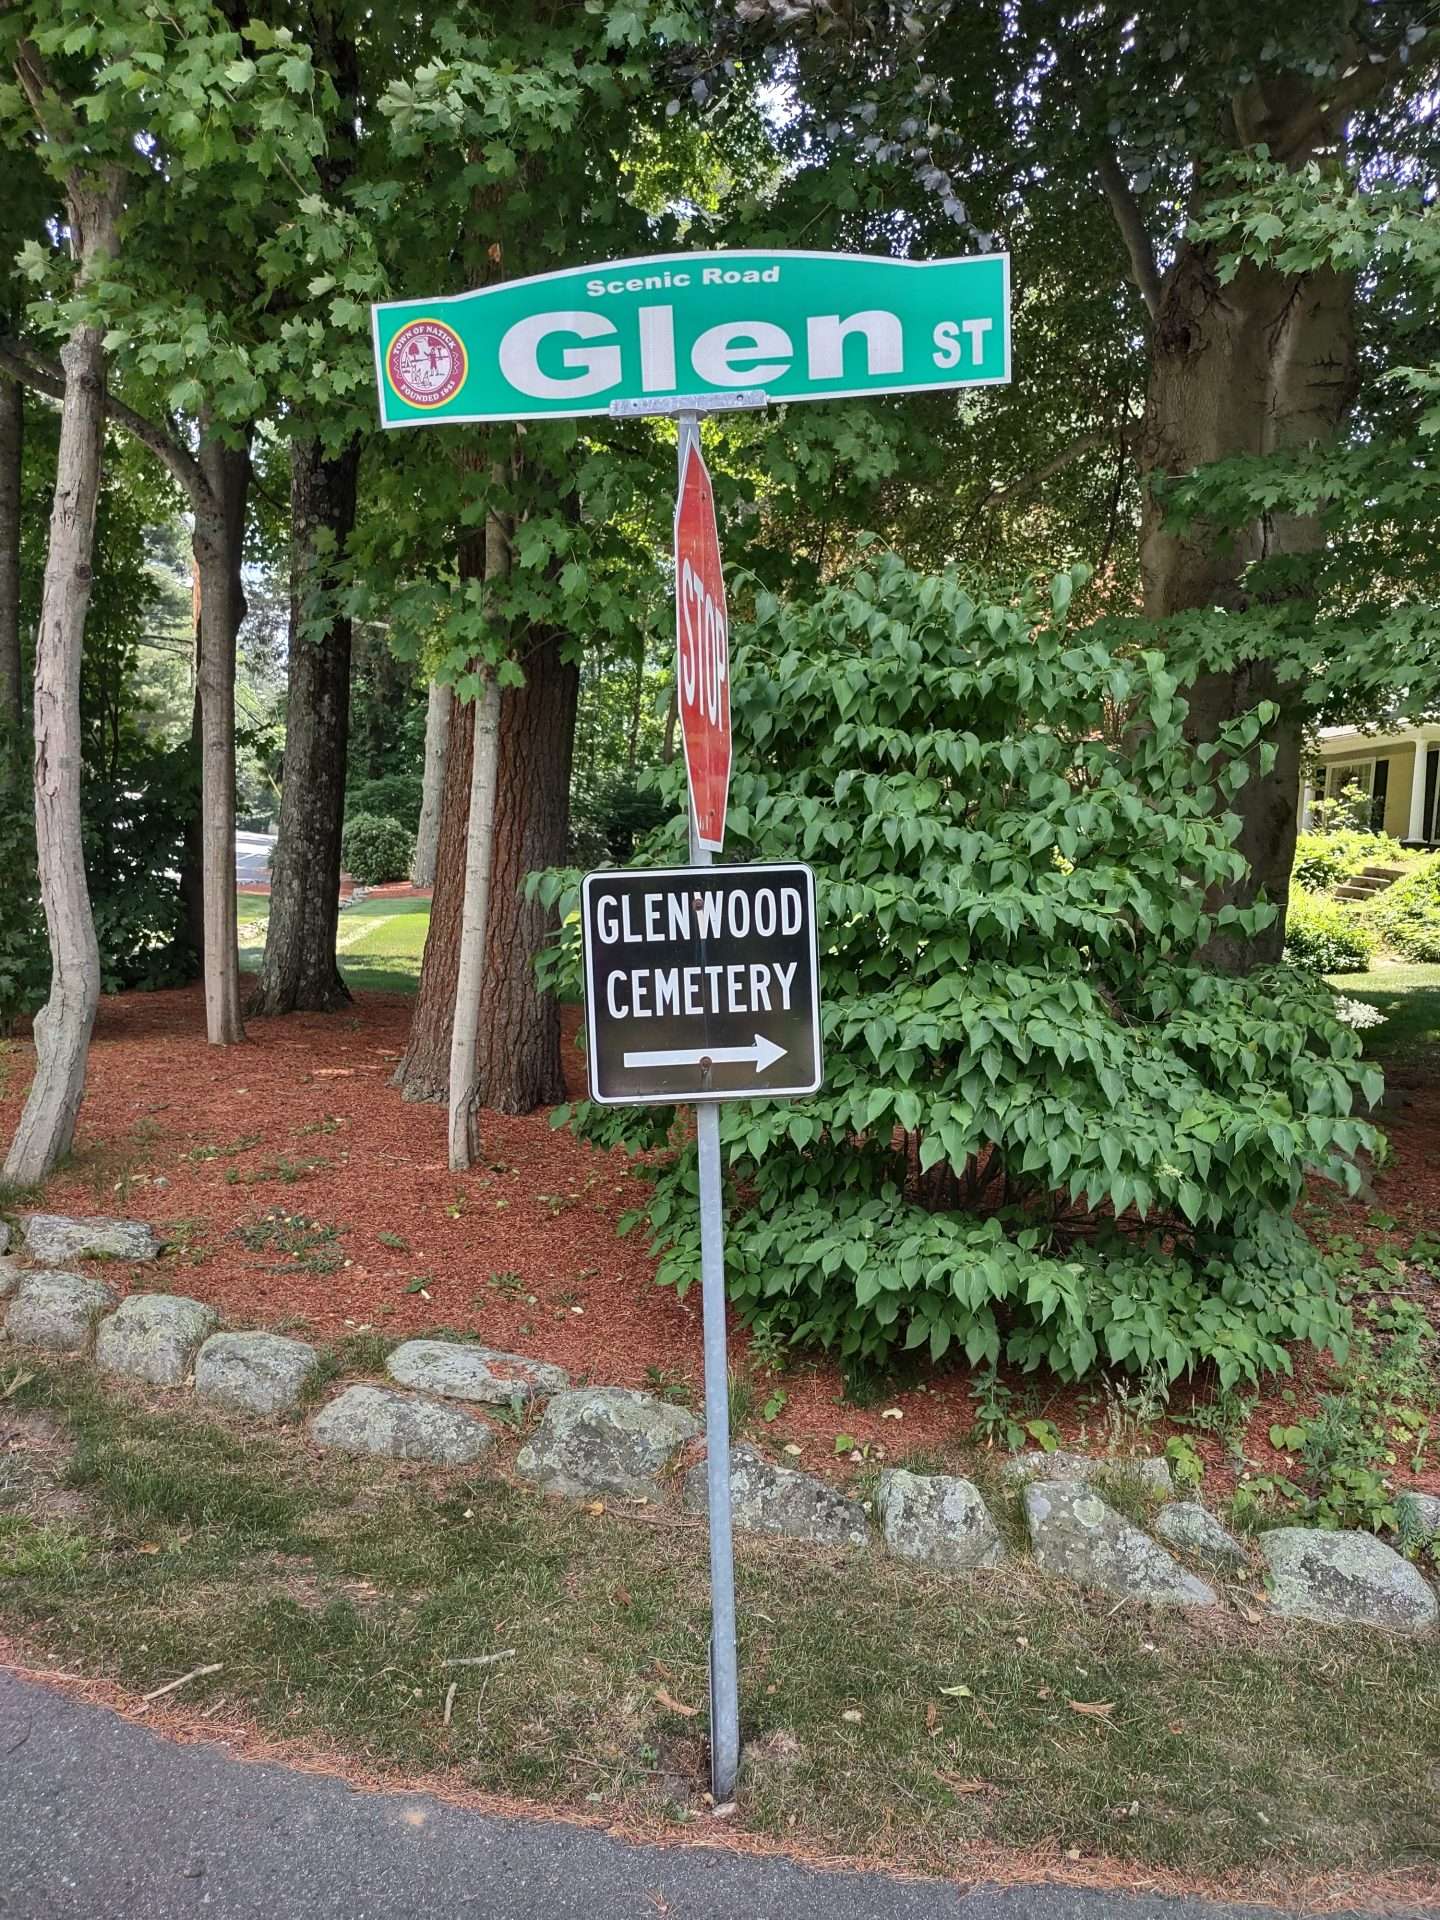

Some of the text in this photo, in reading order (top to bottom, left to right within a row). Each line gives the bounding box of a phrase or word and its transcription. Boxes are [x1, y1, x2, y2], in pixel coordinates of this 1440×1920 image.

[586, 265, 780, 297] Scenic Road
[393, 326, 456, 355] TOWN OF NATICK
[498, 304, 993, 399] Glen ST
[400, 384, 440, 402] FOUNDED
[682, 558, 726, 732] STOP
[597, 888, 802, 944] GLENWOOD
[607, 962, 797, 1019] CEMETERY
